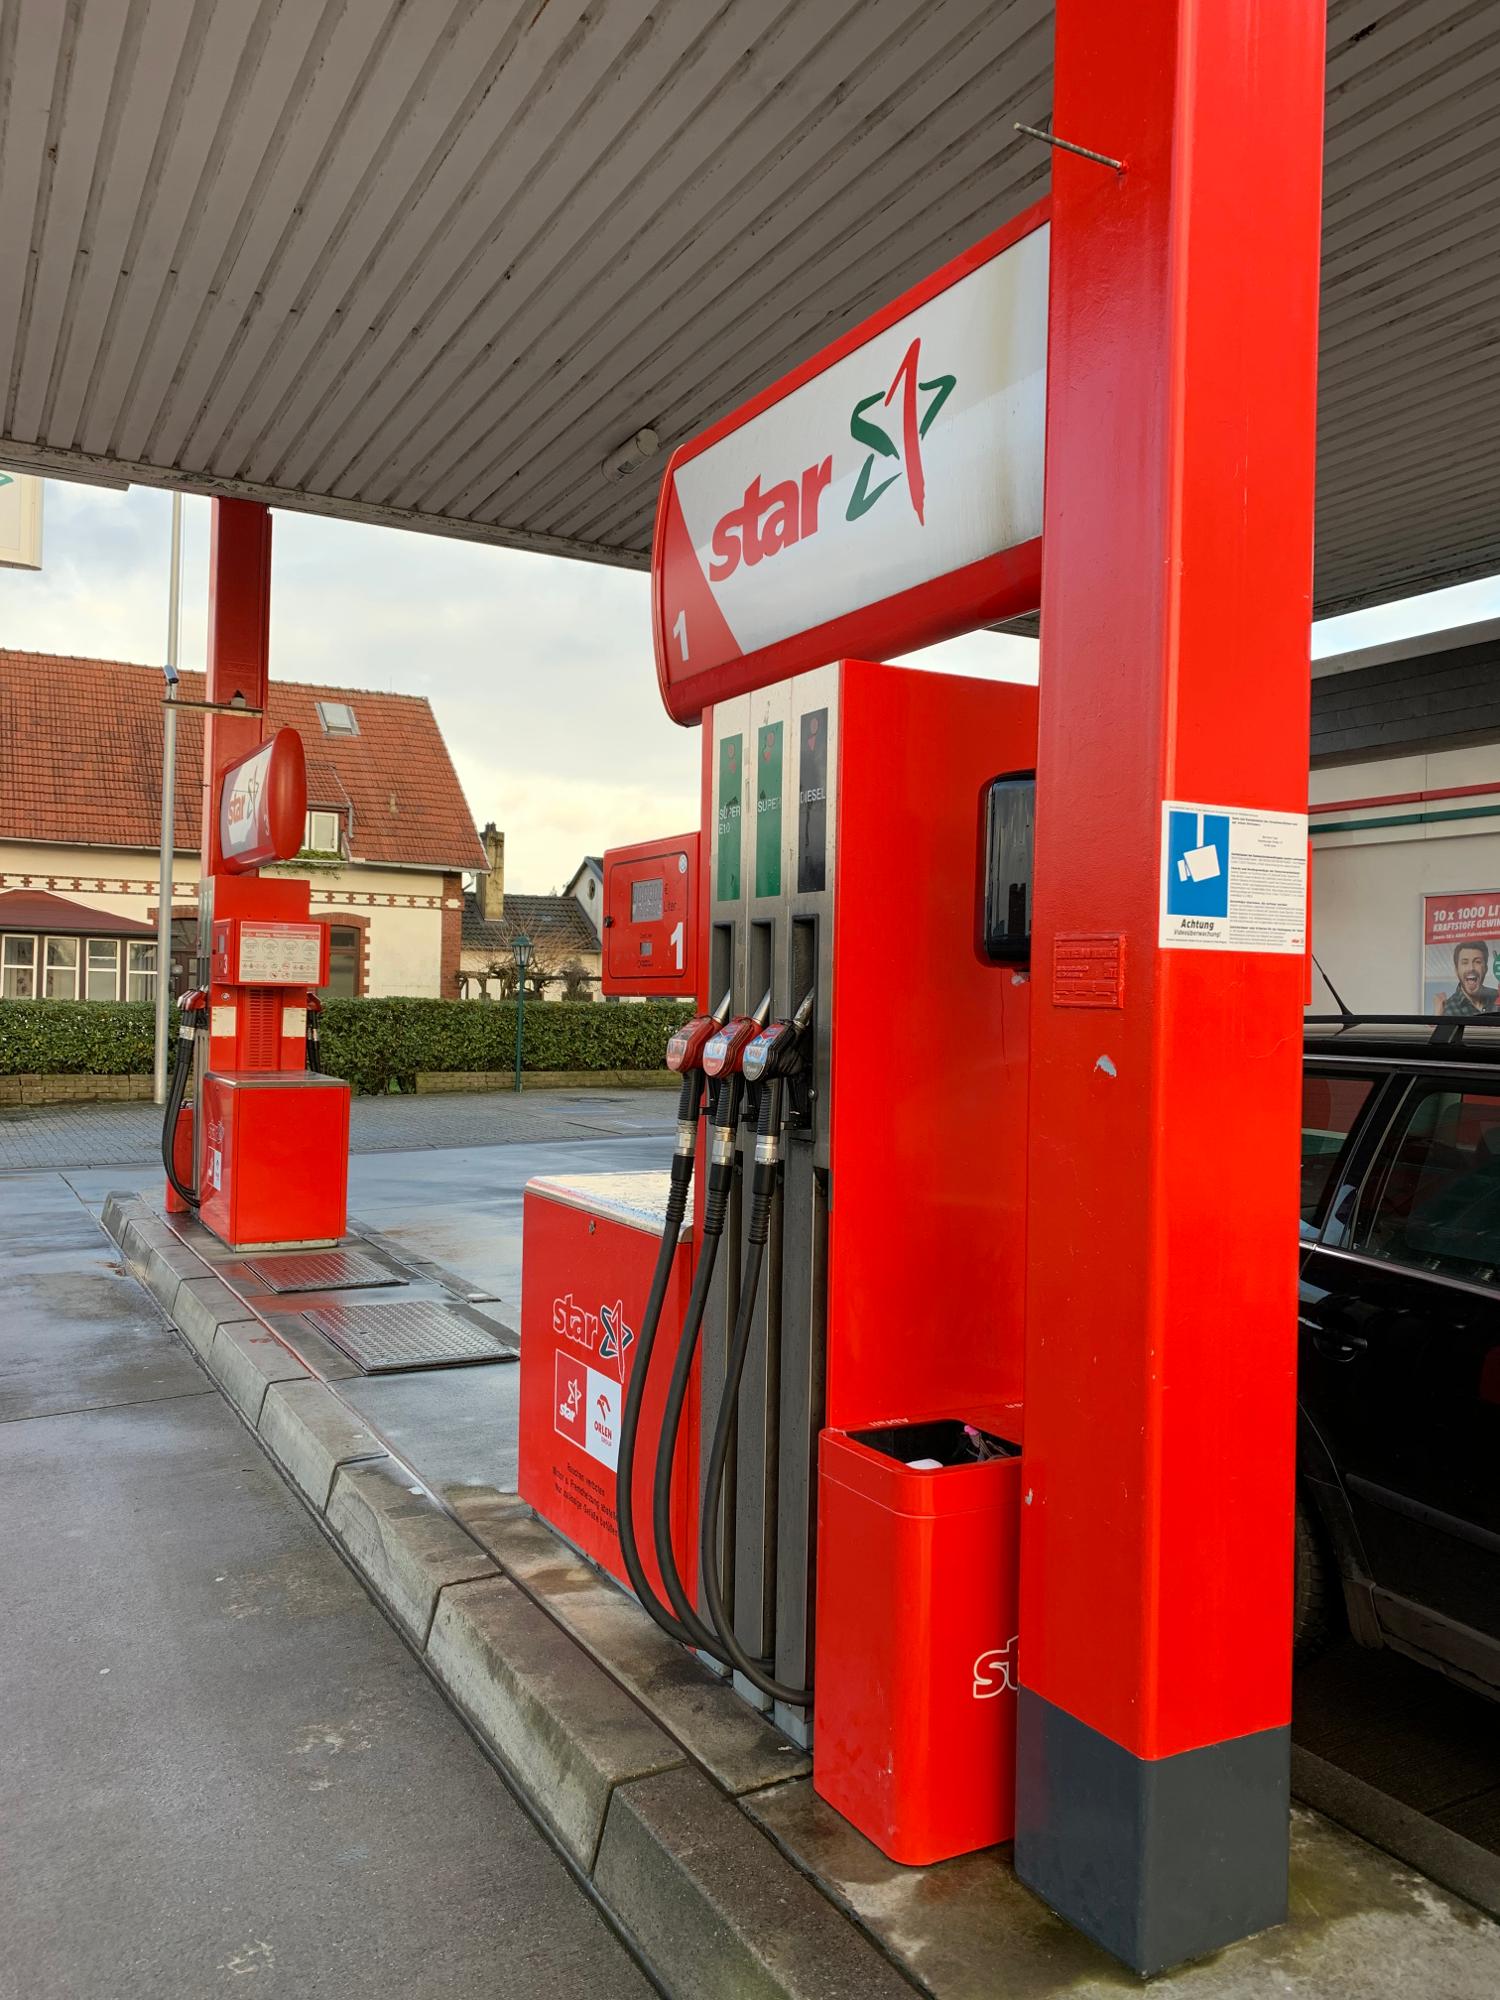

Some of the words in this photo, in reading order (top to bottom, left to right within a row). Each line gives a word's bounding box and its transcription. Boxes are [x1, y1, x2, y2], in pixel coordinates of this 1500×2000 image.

[709, 454, 832, 582] star
[672, 609, 689, 662] 1
[757, 797, 780, 813] SUPE
[800, 787, 826, 803] DIESEL
[228, 794, 246, 826] star
[263, 814, 270, 837] 3
[718, 822, 731, 835] E10
[1180, 918, 1215, 931] Achtung
[1433, 910, 1446, 922] 10
[1447, 911, 1455, 920] x
[1457, 906, 1486, 920] 1000
[1432, 920, 1476, 932] KRAFTSTOFF
[670, 922, 684, 970] 1
[223, 954, 228, 975] 3
[553, 1293, 599, 1350] star
[559, 1402, 577, 1423] star
[593, 1420, 612, 1439] ORLEN
